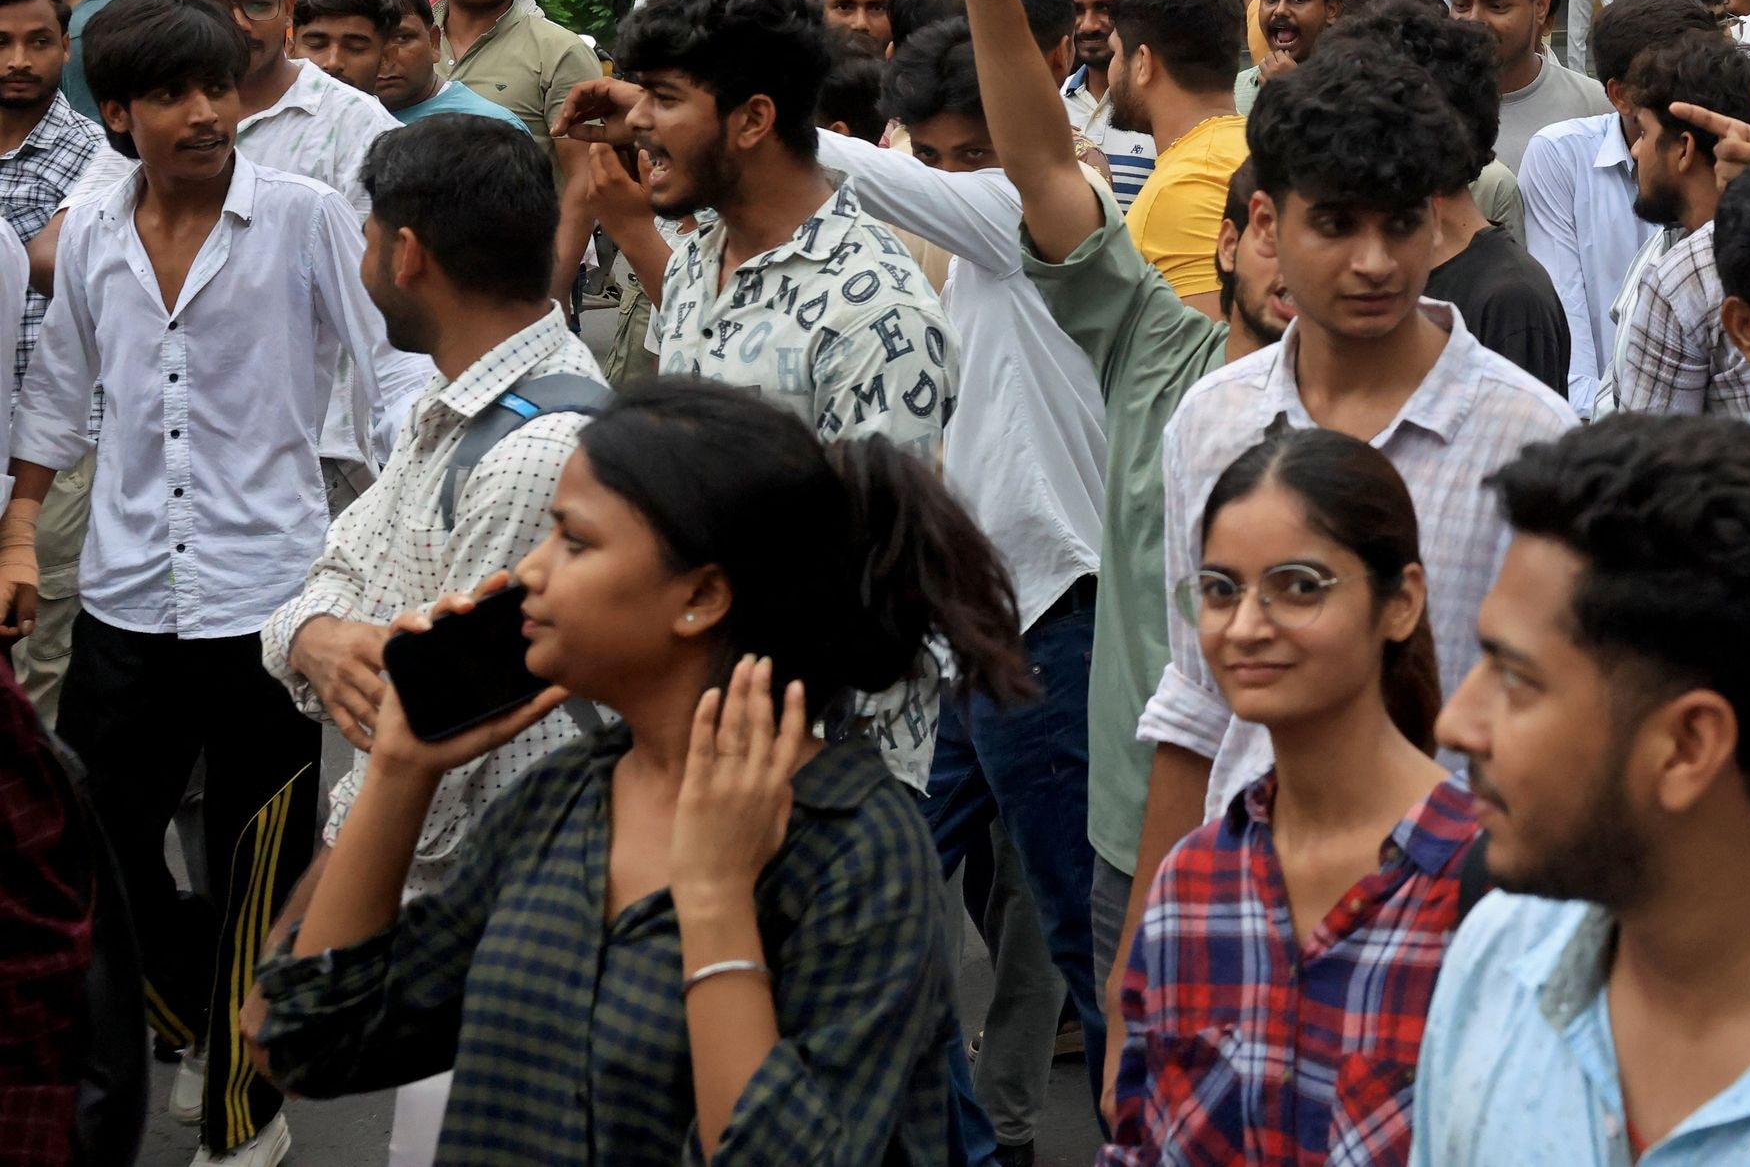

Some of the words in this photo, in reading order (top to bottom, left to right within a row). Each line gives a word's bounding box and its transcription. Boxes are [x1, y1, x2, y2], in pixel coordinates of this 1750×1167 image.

[841, 269, 881, 304] O
[670, 300, 697, 340] Y
[709, 318, 744, 360] Y
[868, 307, 915, 363] E
[775, 346, 805, 394] H
[902, 369, 938, 418] D
[850, 373, 890, 425] M
